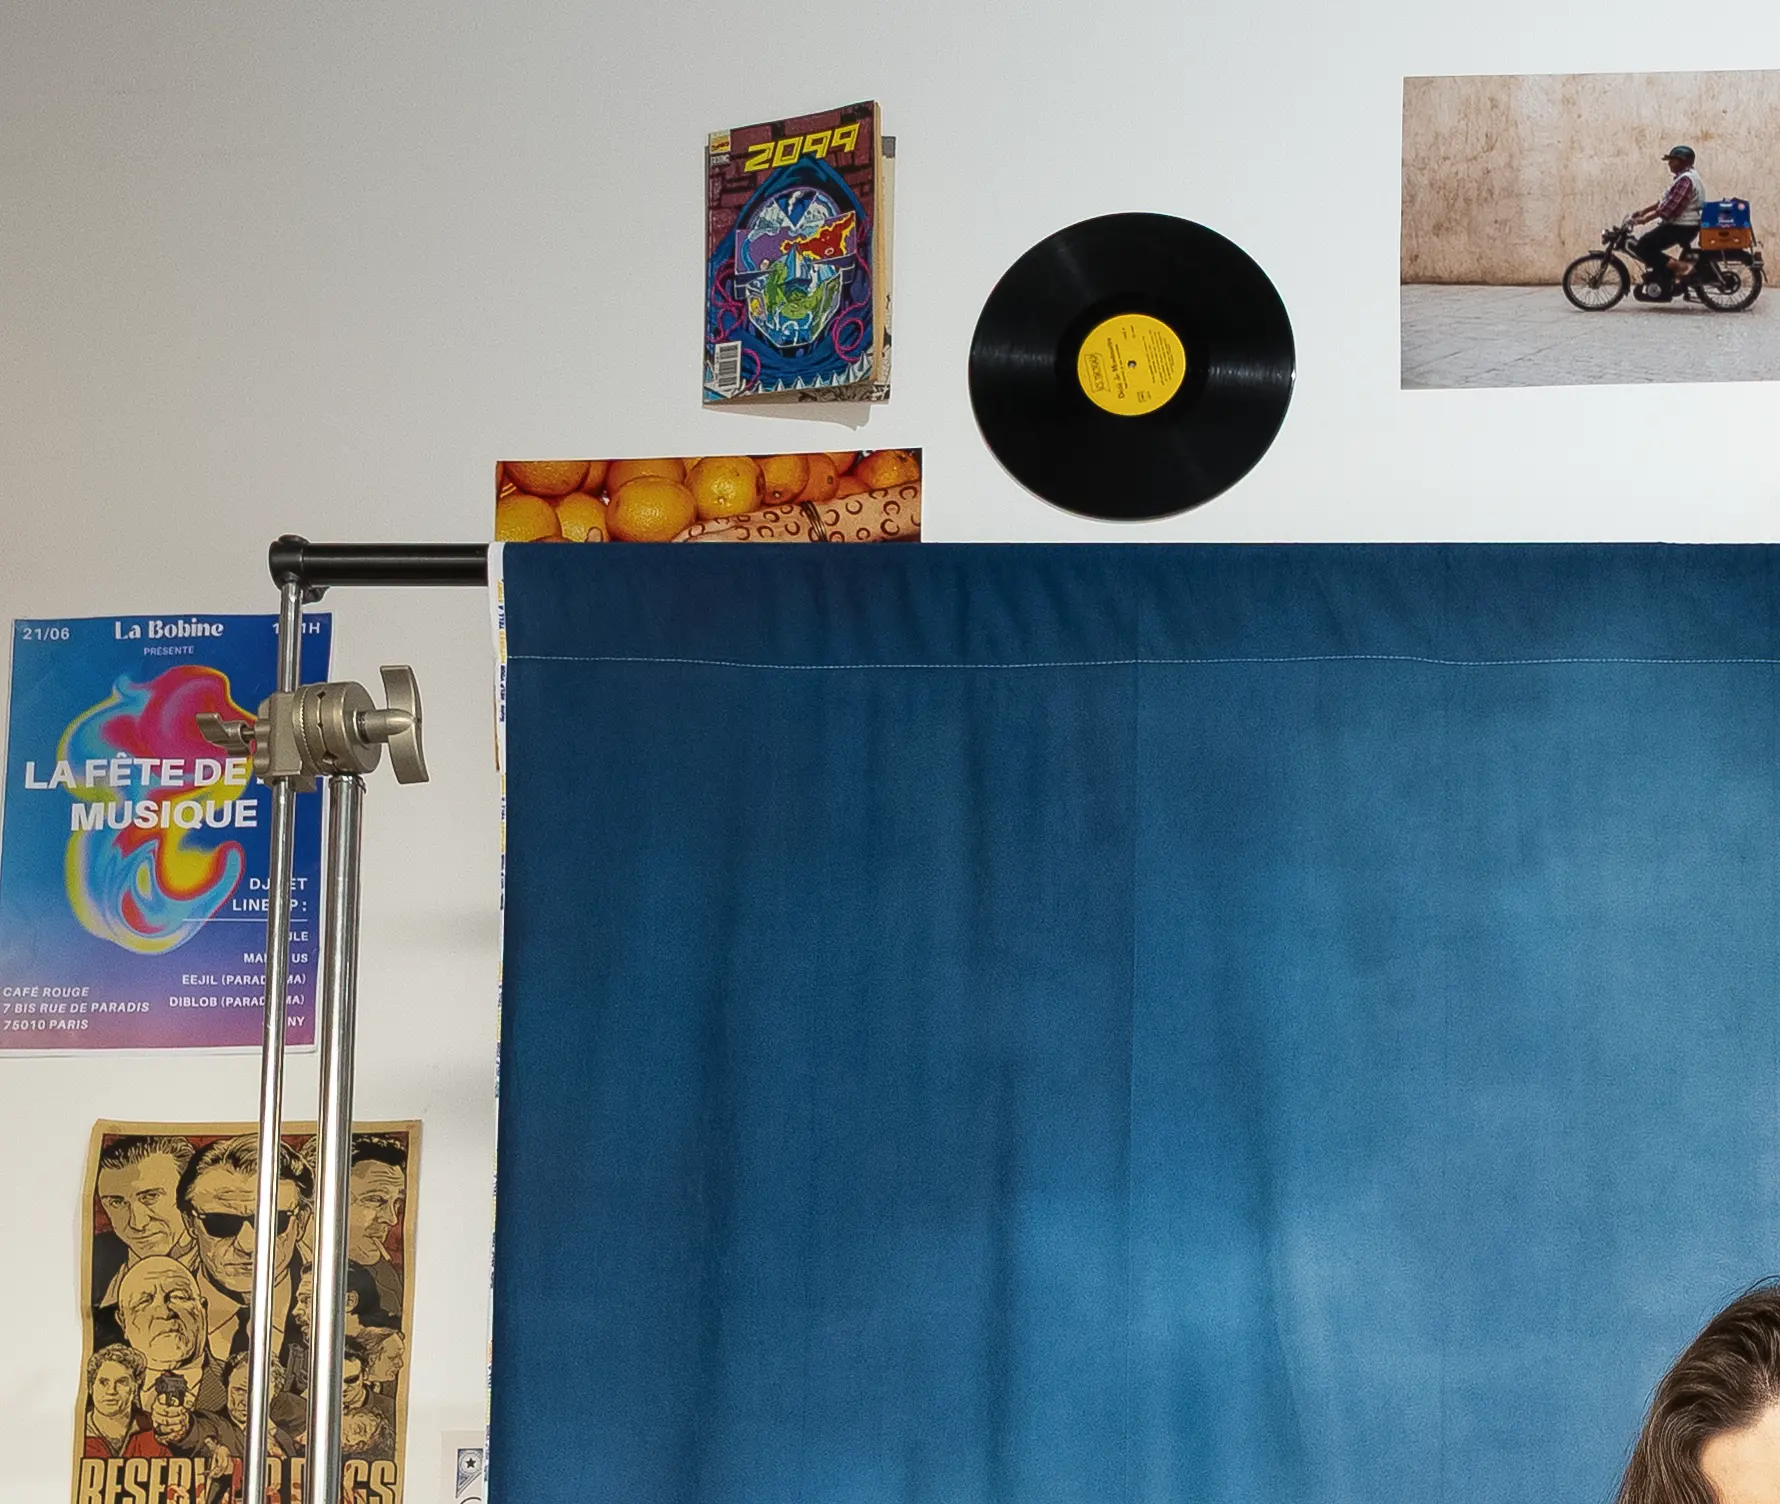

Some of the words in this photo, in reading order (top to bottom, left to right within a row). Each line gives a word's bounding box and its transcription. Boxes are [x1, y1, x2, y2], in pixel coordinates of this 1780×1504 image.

[744, 123, 860, 172] 2099
[22, 628, 71, 641] 21/06
[114, 621, 142, 640] La
[147, 619, 224, 639] Bobine
[25, 760, 77, 790] LA
[86, 752, 185, 788] FÊTE
[193, 757, 248, 786] DE
[71, 799, 258, 831] MUSIQUE
[291, 877, 308, 890] ET
[182, 974, 218, 985] EEJIL
[3, 986, 39, 997] CAFÉ
[43, 986, 89, 998] ROUGE
[169, 996, 218, 1007] DIBLOB
[3, 1003, 11, 1014] 7
[15, 1003, 36, 1013] BIS
[40, 1003, 67, 1013] RUE
[70, 1003, 88, 1013] DE
[91, 1002, 150, 1012] PARADIS
[3, 1019, 46, 1031] 75010
[49, 1019, 89, 1030] PARIS
